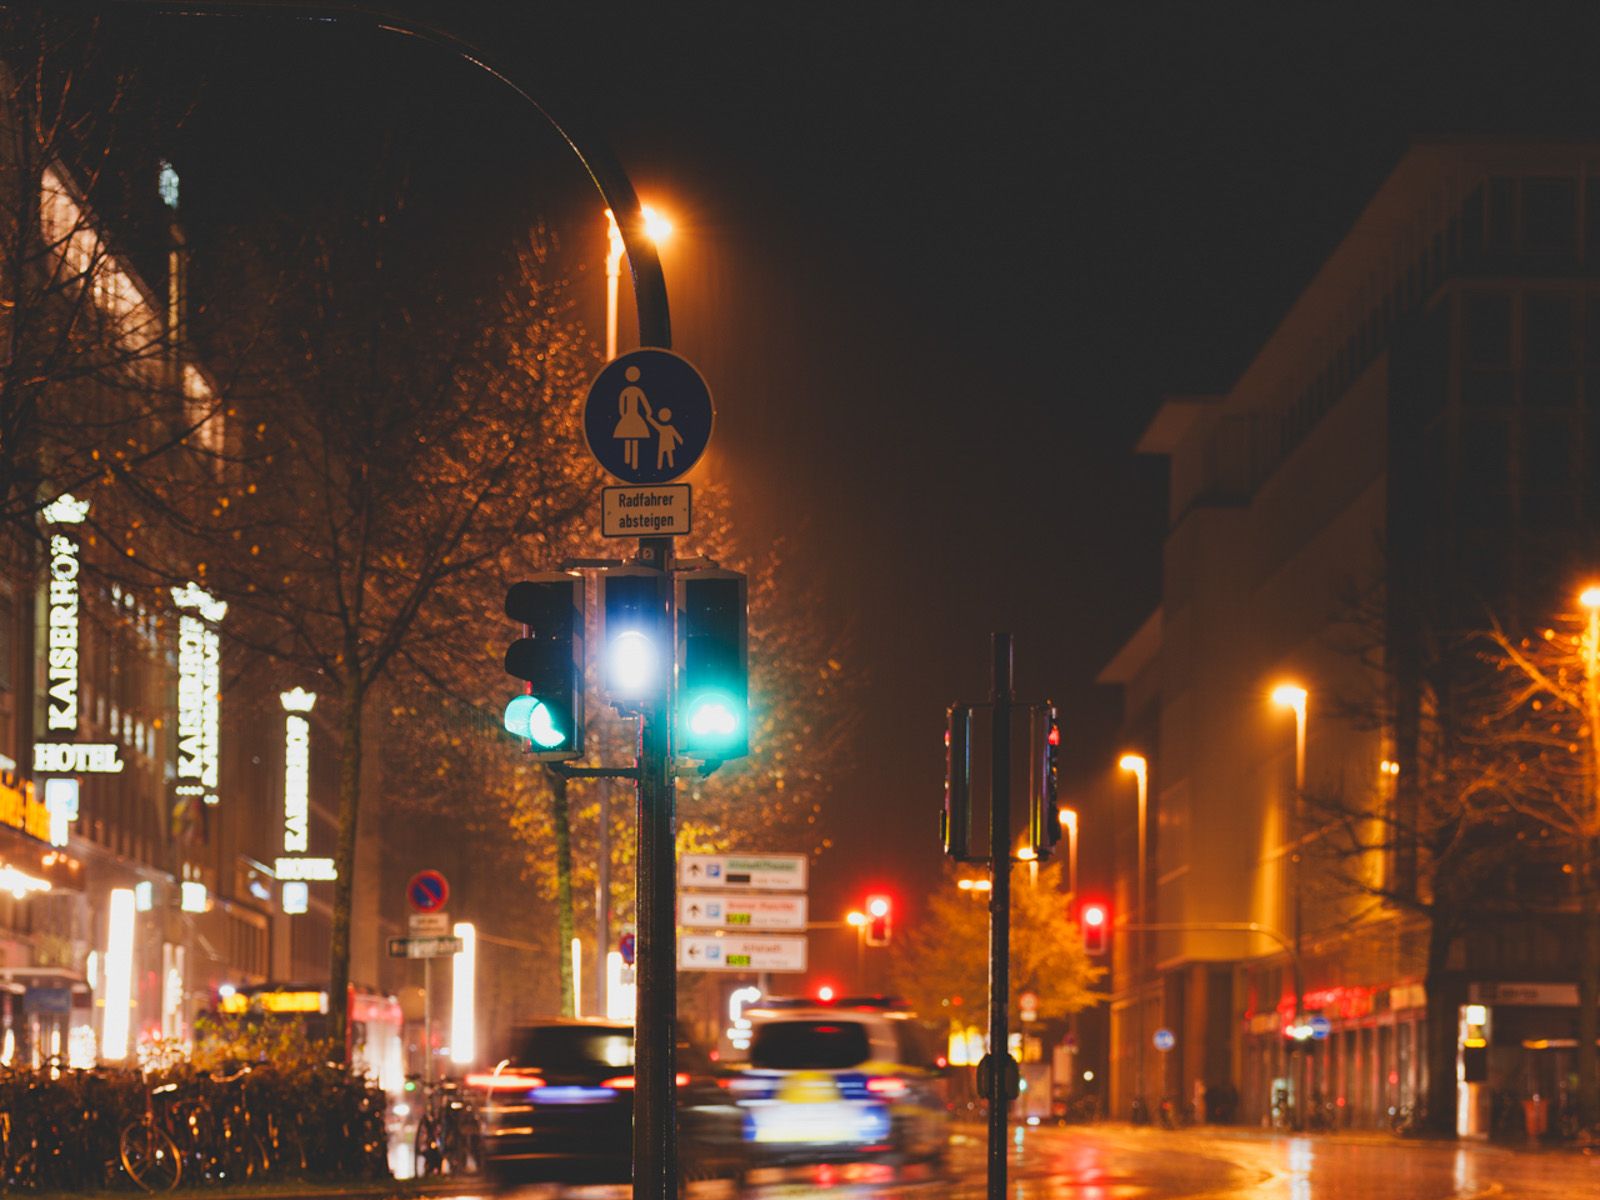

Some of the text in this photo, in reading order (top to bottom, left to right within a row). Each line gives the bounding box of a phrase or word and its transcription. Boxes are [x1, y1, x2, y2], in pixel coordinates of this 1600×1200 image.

[618, 493, 674, 507] Radfahrer
[618, 513, 674, 530] absteigen
[49, 534, 79, 730] KAISERHOF
[178, 615, 204, 778] KAISERHOF
[33, 743, 124, 772] HOTEL
[284, 715, 309, 852] KAHOF
